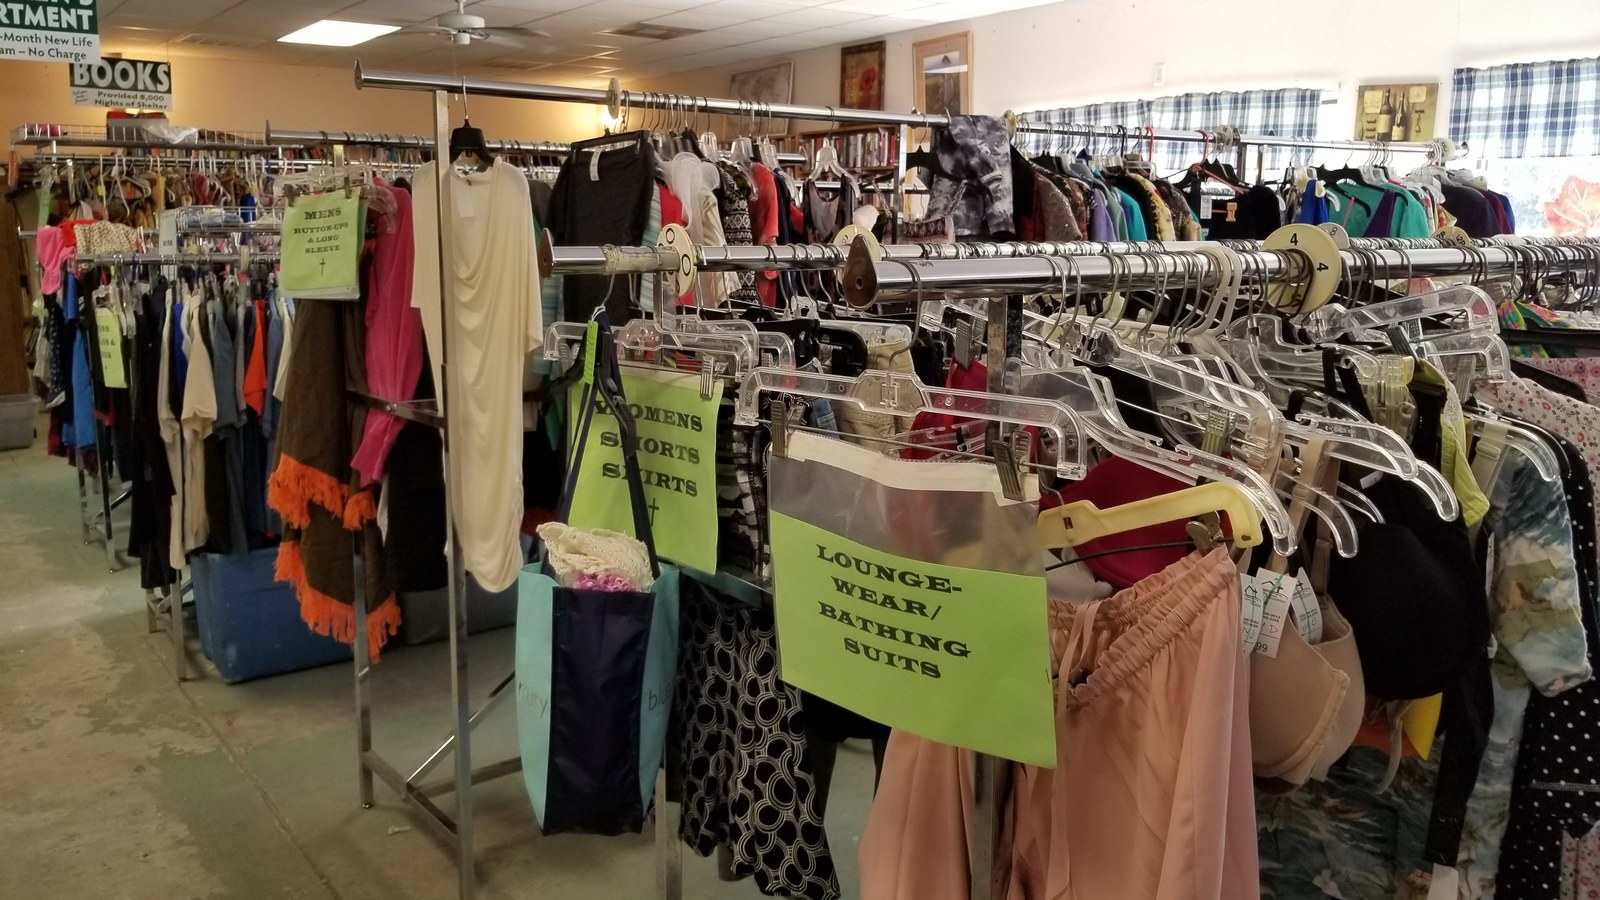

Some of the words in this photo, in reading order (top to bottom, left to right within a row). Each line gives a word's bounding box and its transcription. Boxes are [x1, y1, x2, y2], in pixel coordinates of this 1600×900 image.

[45, 35, 69, 45] New
[72, 37, 93, 47] Life
[28, 47, 45, 57] No
[48, 48, 87, 62] Charge
[73, 59, 170, 92] BOOKS
[98, 90, 138, 99] Provided
[140, 94, 165, 102] 8,000
[94, 98, 123, 108] Nights
[137, 101, 168, 110] Shelter
[304, 207, 342, 220] MENS
[293, 222, 349, 234] BUTTON-UPS
[315, 235, 339, 243] LONG
[1289, 232, 1299, 246] 4
[304, 244, 341, 254] SLEEVE
[1316, 262, 1329, 272] 4
[595, 400, 703, 433] WOMENS
[602, 462, 698, 497] SIRTS
[815, 544, 963, 594] LOUNGE-
[830, 575, 942, 620] WEAR/
[817, 600, 973, 659] BATHING
[843, 636, 942, 679] SUITS
